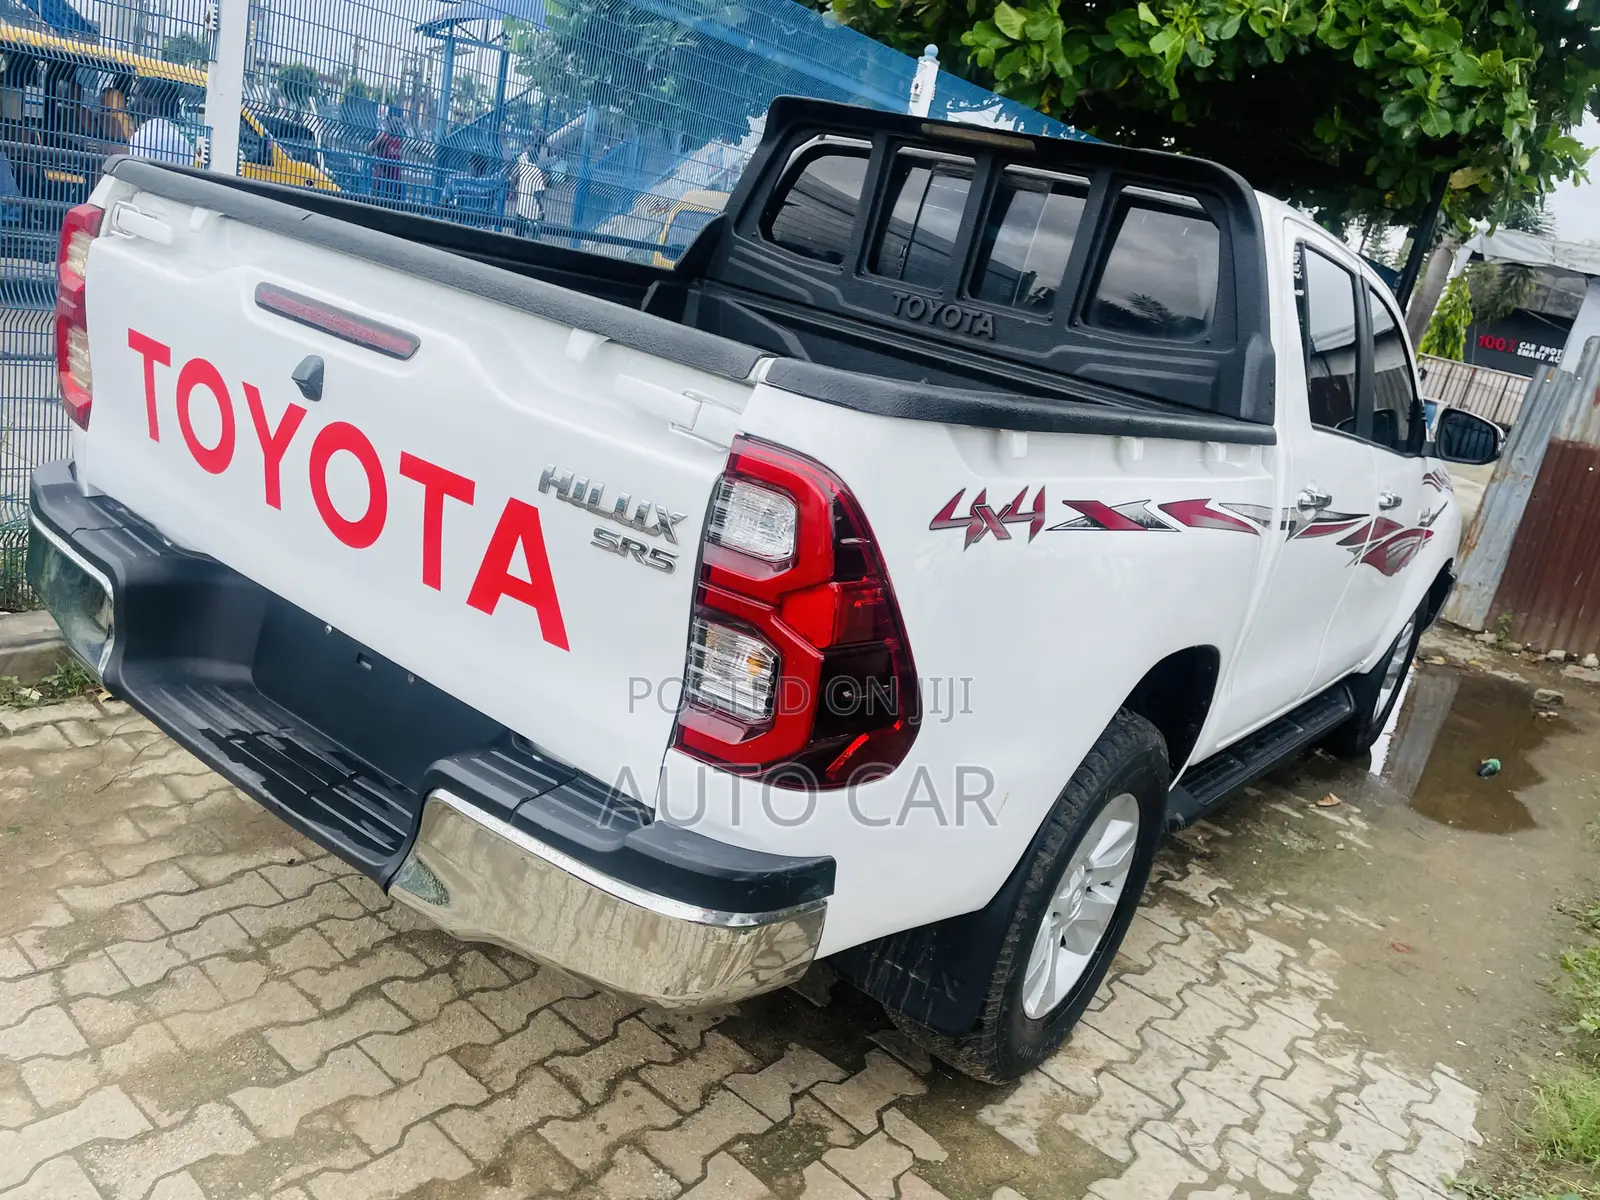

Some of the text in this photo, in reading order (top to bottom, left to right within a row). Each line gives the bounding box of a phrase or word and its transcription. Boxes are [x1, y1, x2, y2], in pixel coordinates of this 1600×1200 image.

[892, 290, 996, 341] TOYOTA
[1517, 348, 1547, 360] SMART
[1519, 341, 1537, 352] CAR
[127, 327, 571, 652] TOYOTA
[538, 462, 688, 545] HILUX
[590, 526, 679, 574] SR5
